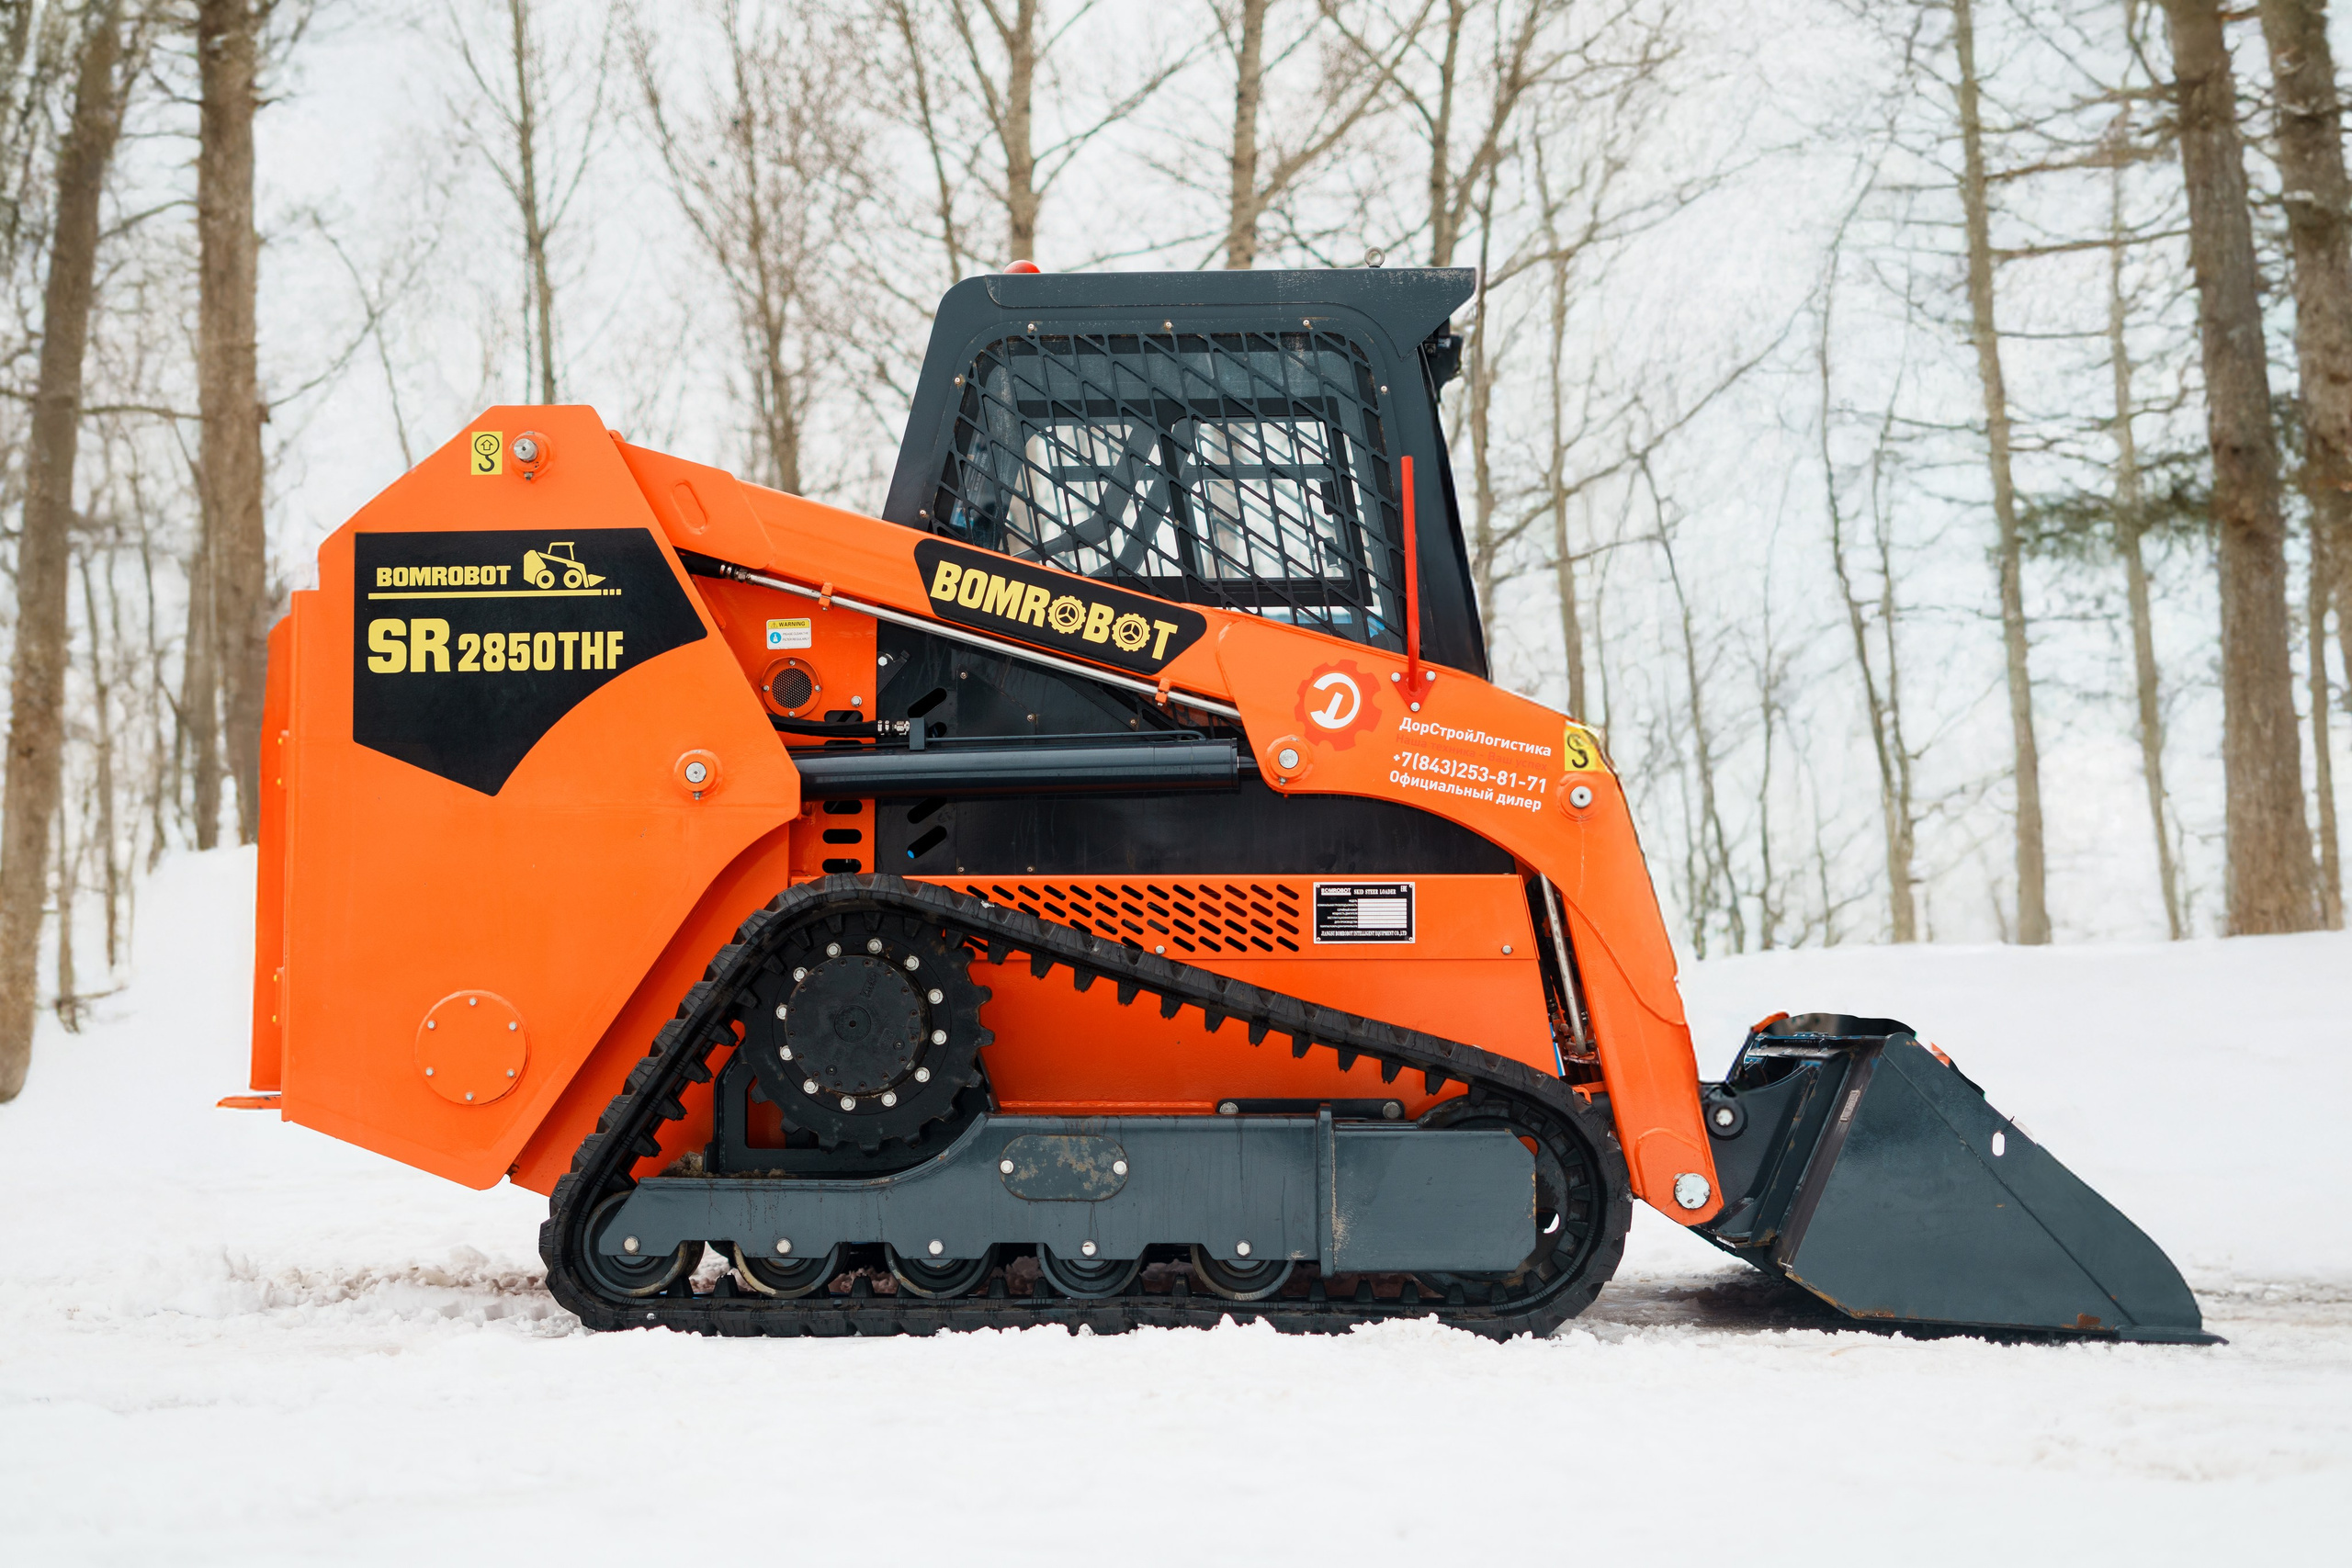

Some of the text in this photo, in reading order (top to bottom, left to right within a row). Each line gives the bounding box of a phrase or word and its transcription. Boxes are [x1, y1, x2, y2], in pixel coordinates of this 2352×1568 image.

[377, 565, 511, 586] BOMROBOT
[930, 560, 1178, 660] BOMROBOT
[368, 618, 624, 674] SR 2850THF
[1396, 733, 1427, 749] Наша
[1430, 740, 1476, 758] техника
[1487, 751, 1513, 765] Ваш
[1515, 758, 1547, 772] успех
[1398, 716, 1552, 757] ДорСтройЛогистика
[1389, 770, 1542, 812] Официальный дилер
[1393, 750, 1546, 794] +7(843)253-81-71
